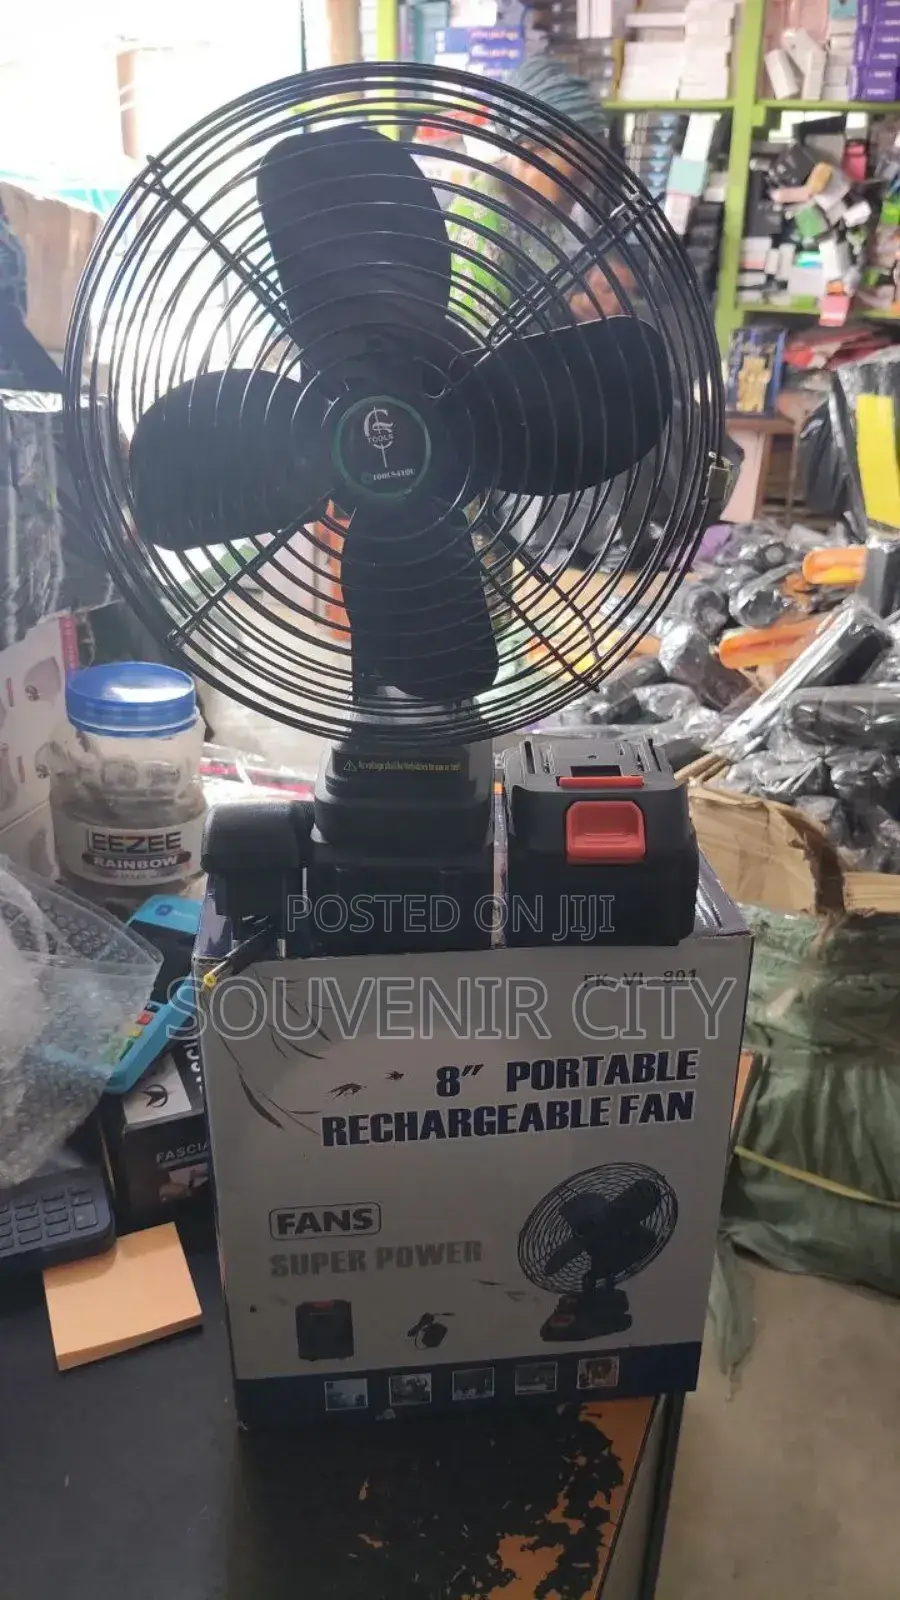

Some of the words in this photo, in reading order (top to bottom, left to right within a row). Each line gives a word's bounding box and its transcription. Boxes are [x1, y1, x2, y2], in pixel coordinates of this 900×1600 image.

[91, 831, 182, 853] EEZEE
[93, 856, 179, 870] RAINBOW
[506, 1048, 699, 1092] PORTABLE
[321, 1096, 611, 1147] RECHARGEABLE
[619, 1090, 695, 1125] FAN
[276, 1207, 374, 1235] FANS
[269, 1249, 367, 1278] SUPER
[375, 1240, 482, 1271] POWER
